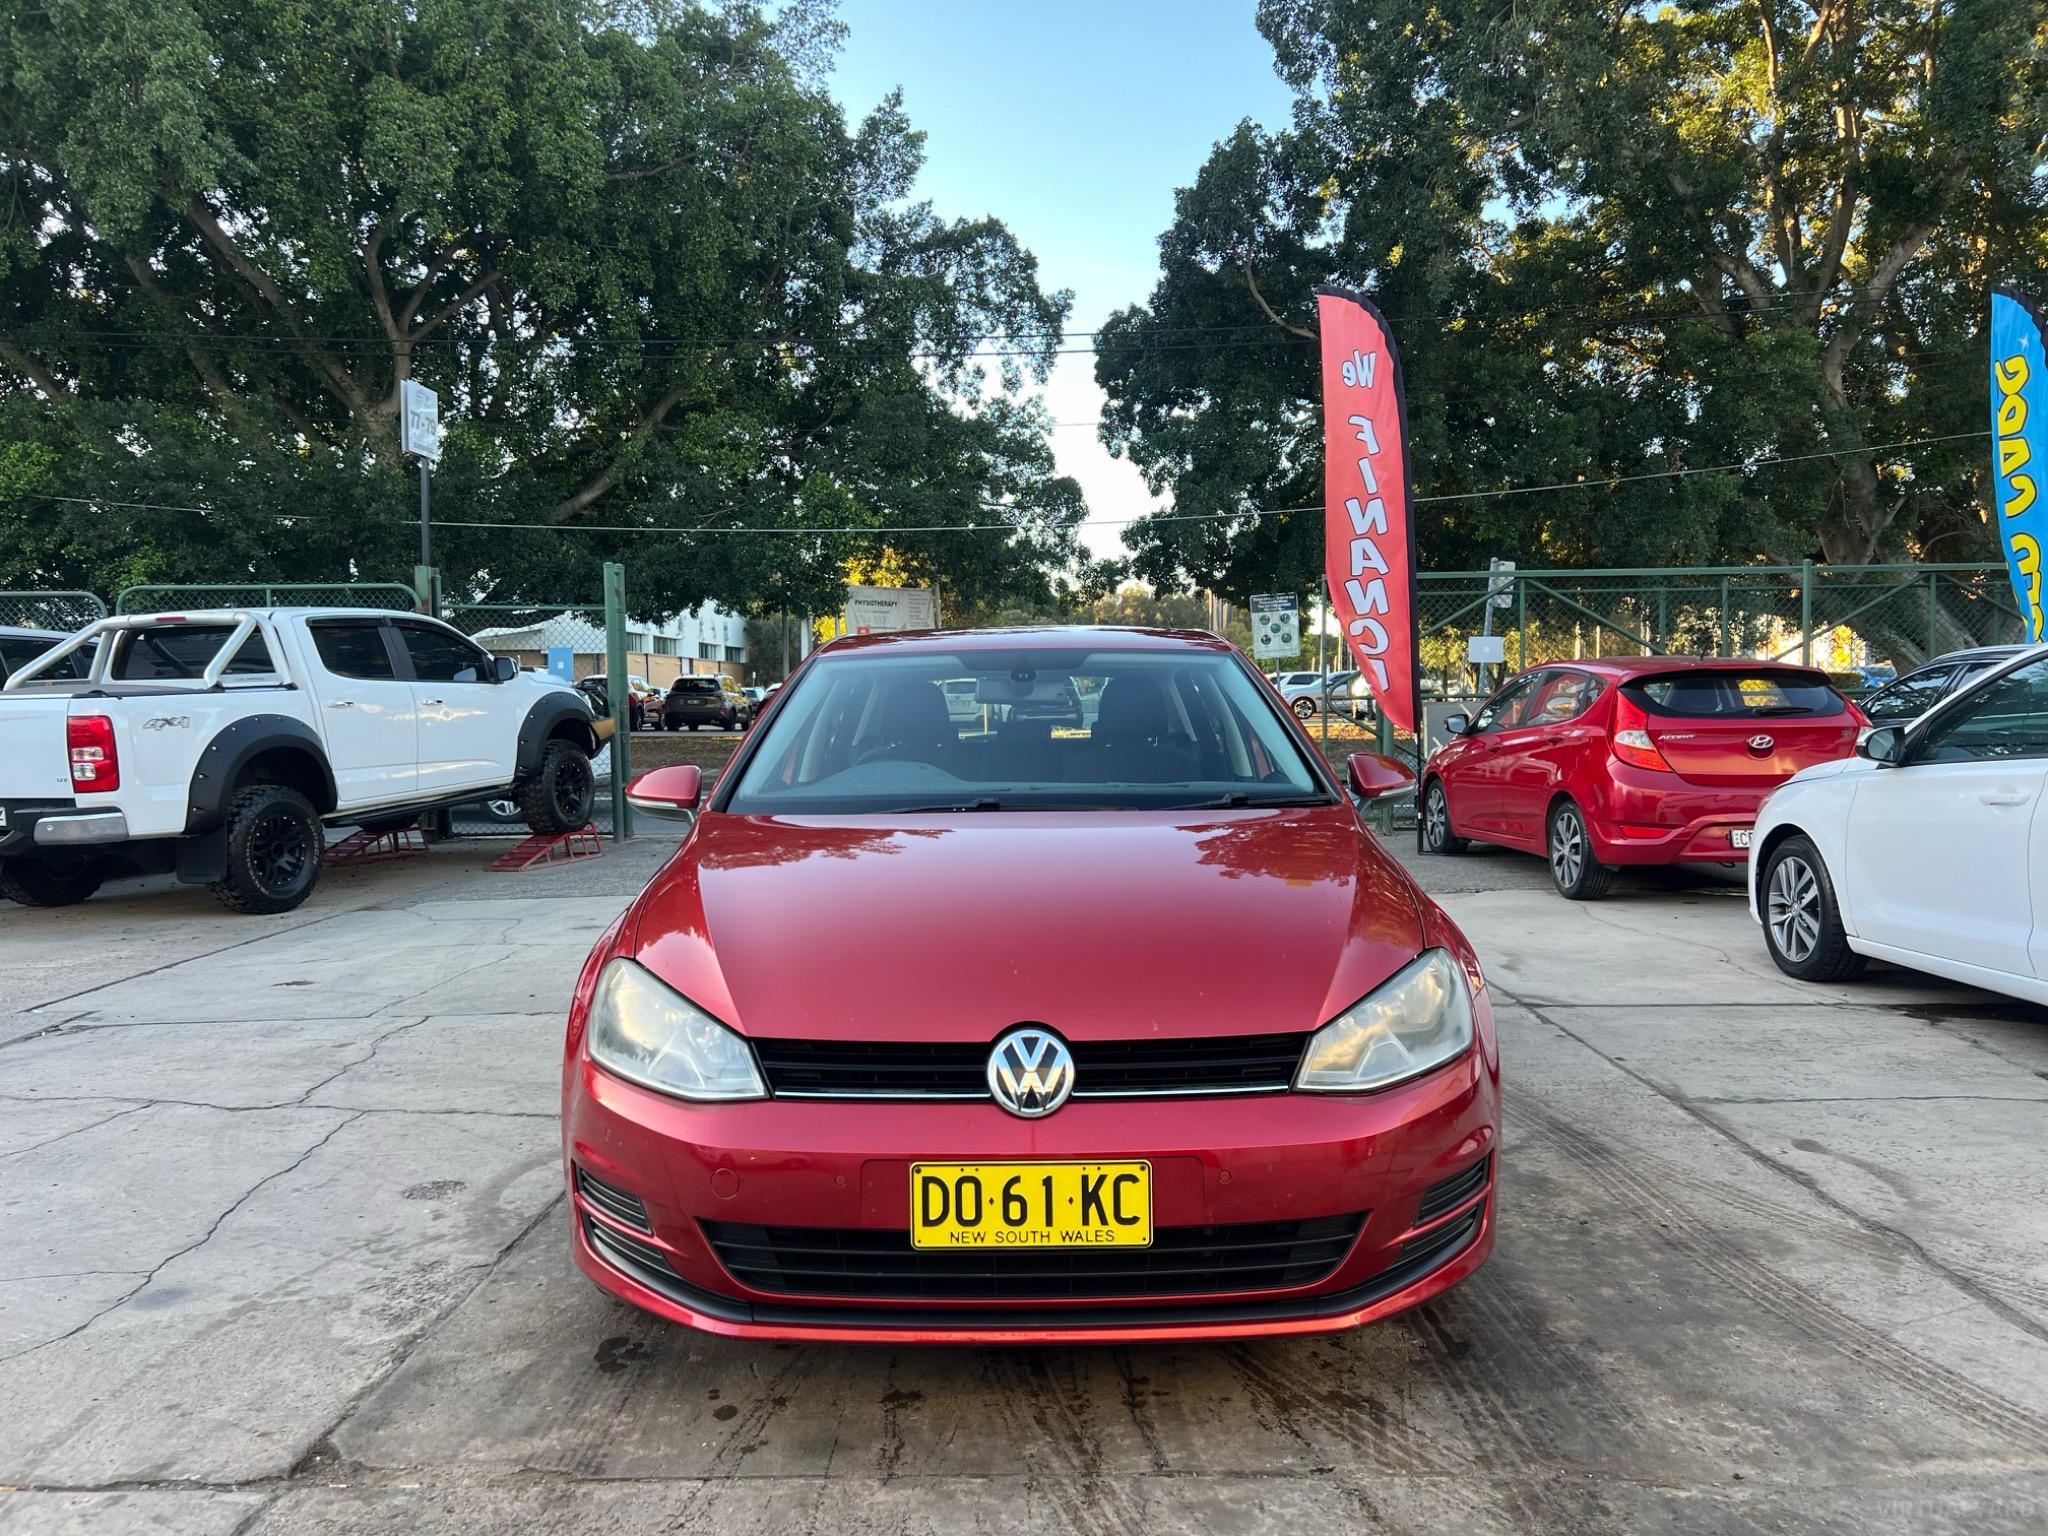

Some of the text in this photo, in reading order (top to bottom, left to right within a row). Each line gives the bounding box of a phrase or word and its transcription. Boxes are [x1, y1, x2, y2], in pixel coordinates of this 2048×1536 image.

[855, 600, 898, 608] PHYSIOTHERAPY
[950, 1229, 1115, 1243] NEW SOUTH WALES
